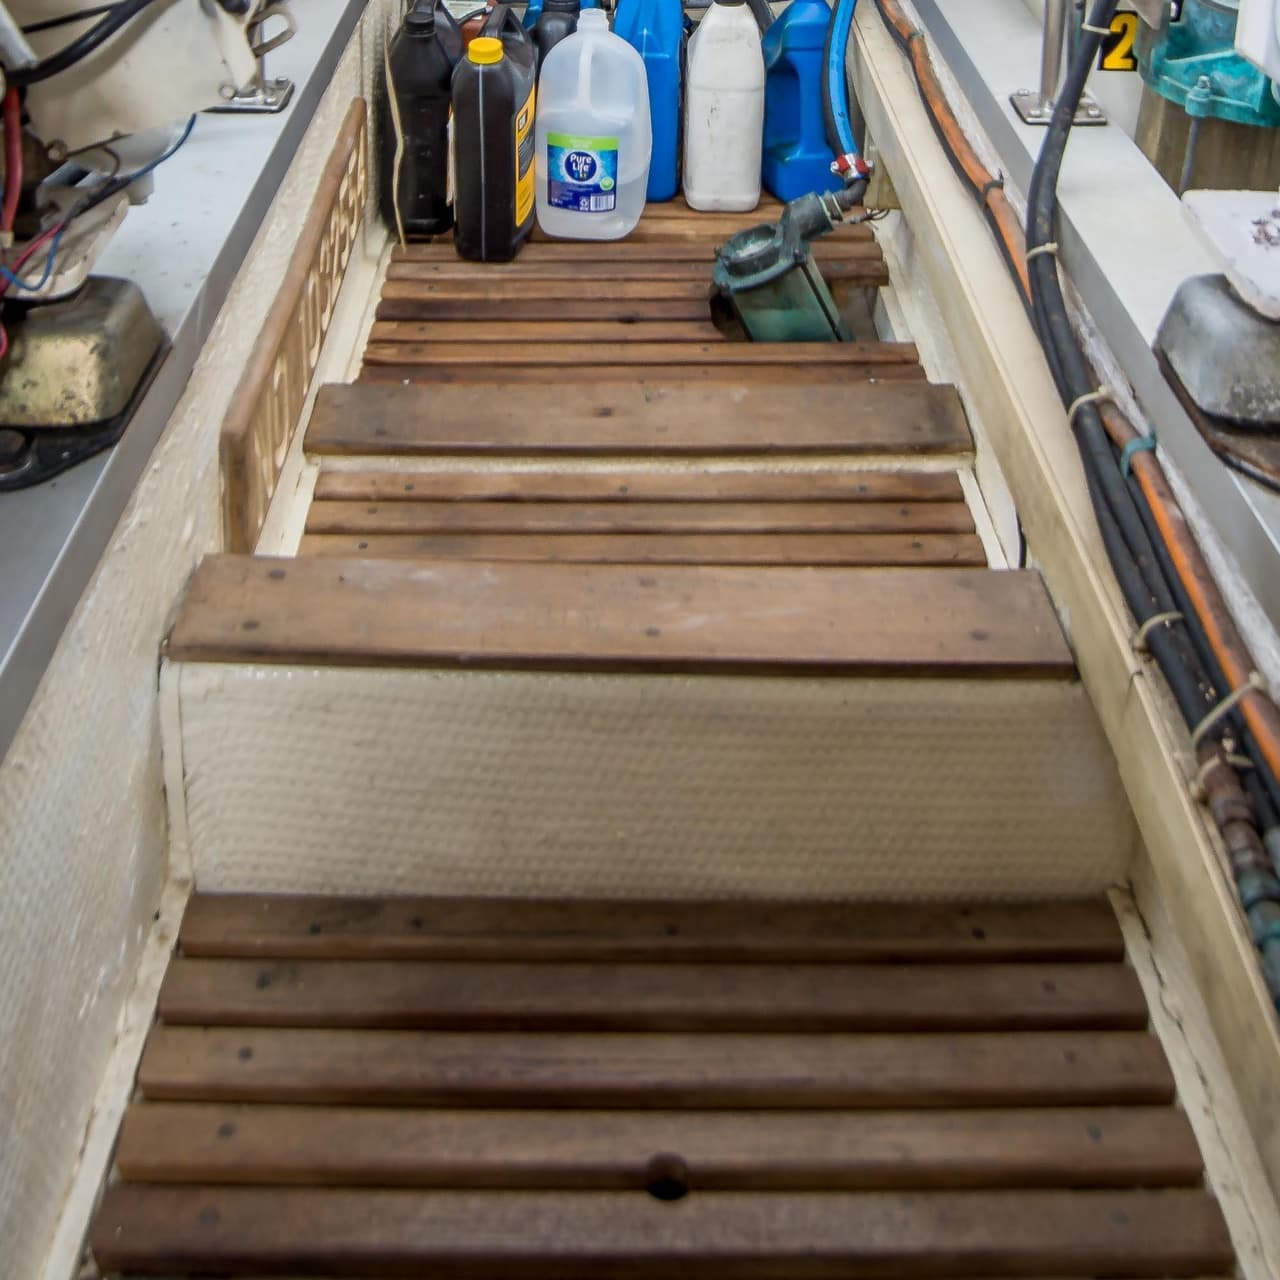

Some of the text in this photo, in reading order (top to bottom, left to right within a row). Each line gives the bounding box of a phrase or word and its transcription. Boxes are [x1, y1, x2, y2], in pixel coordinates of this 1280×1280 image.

[1103, 13, 1138, 70] 2
[570, 153, 592, 165] Pure
[572, 162, 590, 173] Life
